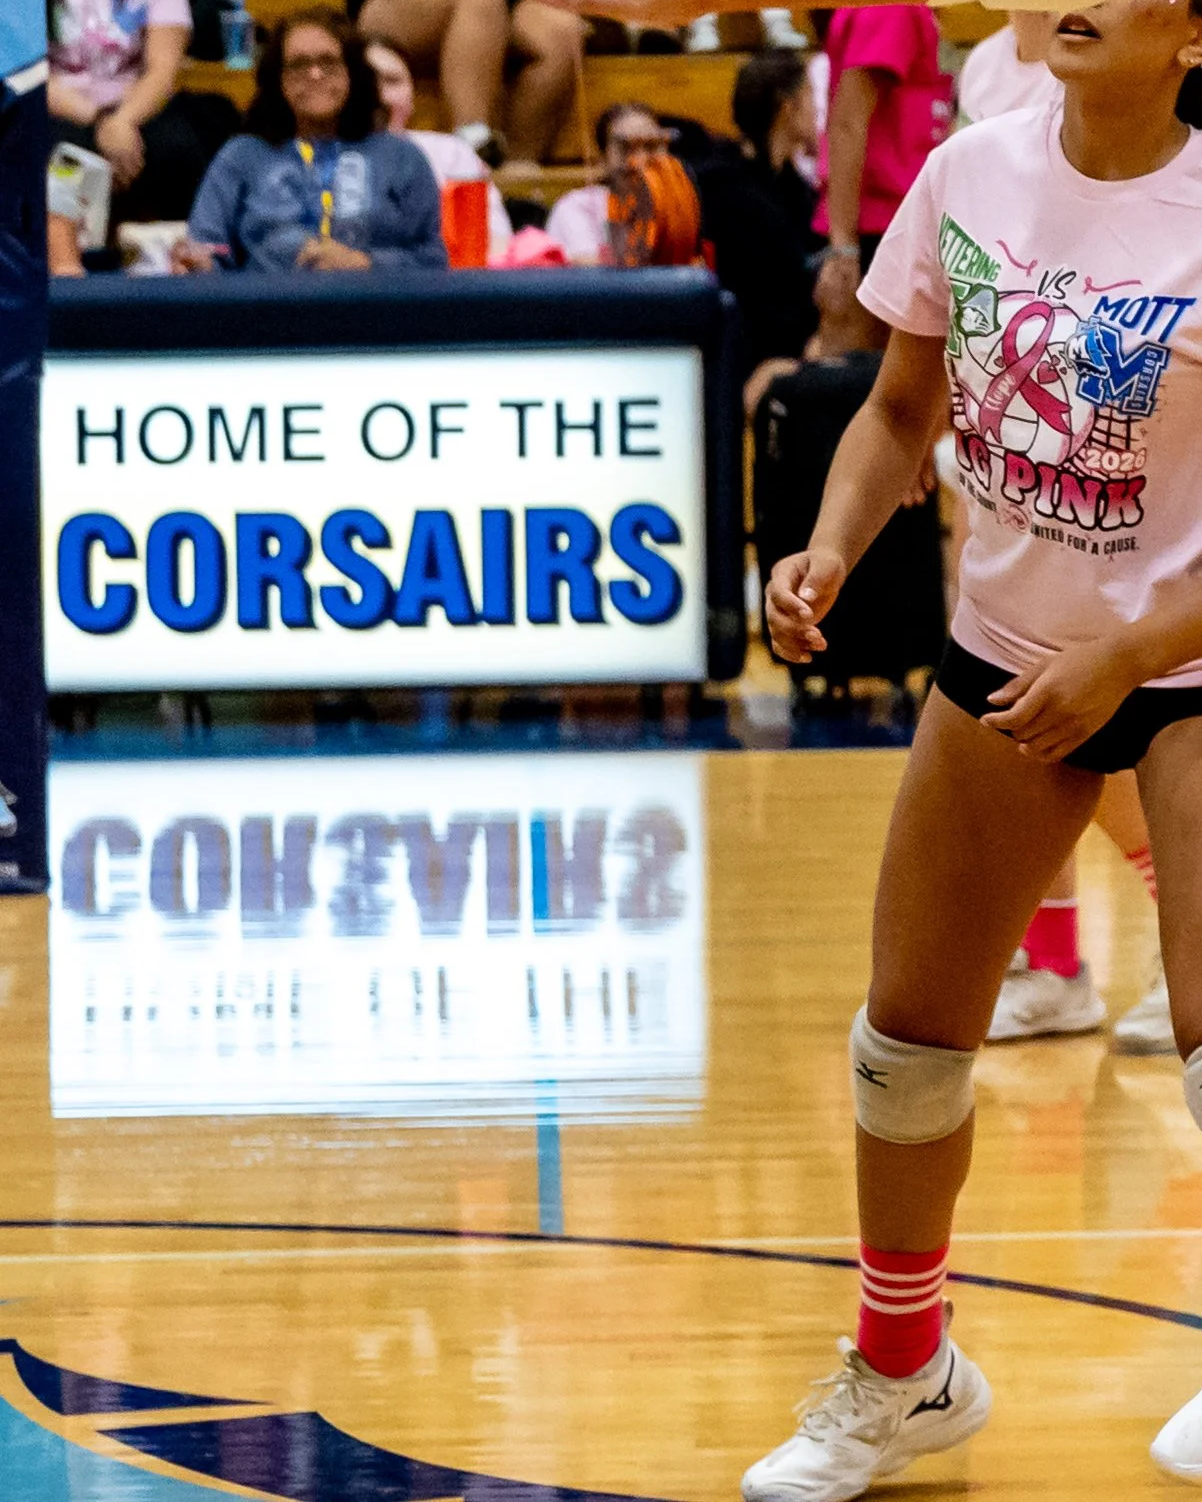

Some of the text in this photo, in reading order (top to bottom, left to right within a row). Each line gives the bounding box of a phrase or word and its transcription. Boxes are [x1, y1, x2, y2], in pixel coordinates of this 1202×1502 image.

[1093, 295, 1197, 343] MOTT
[76, 396, 662, 465] HOME OF THE
[1084, 447, 1147, 472] 2026
[955, 430, 992, 491] IG
[1001, 450, 1147, 531] PINK
[56, 502, 684, 634] CORSAIRS
[1067, 534, 1087, 552] FOR
[1091, 542, 1099, 555] A
